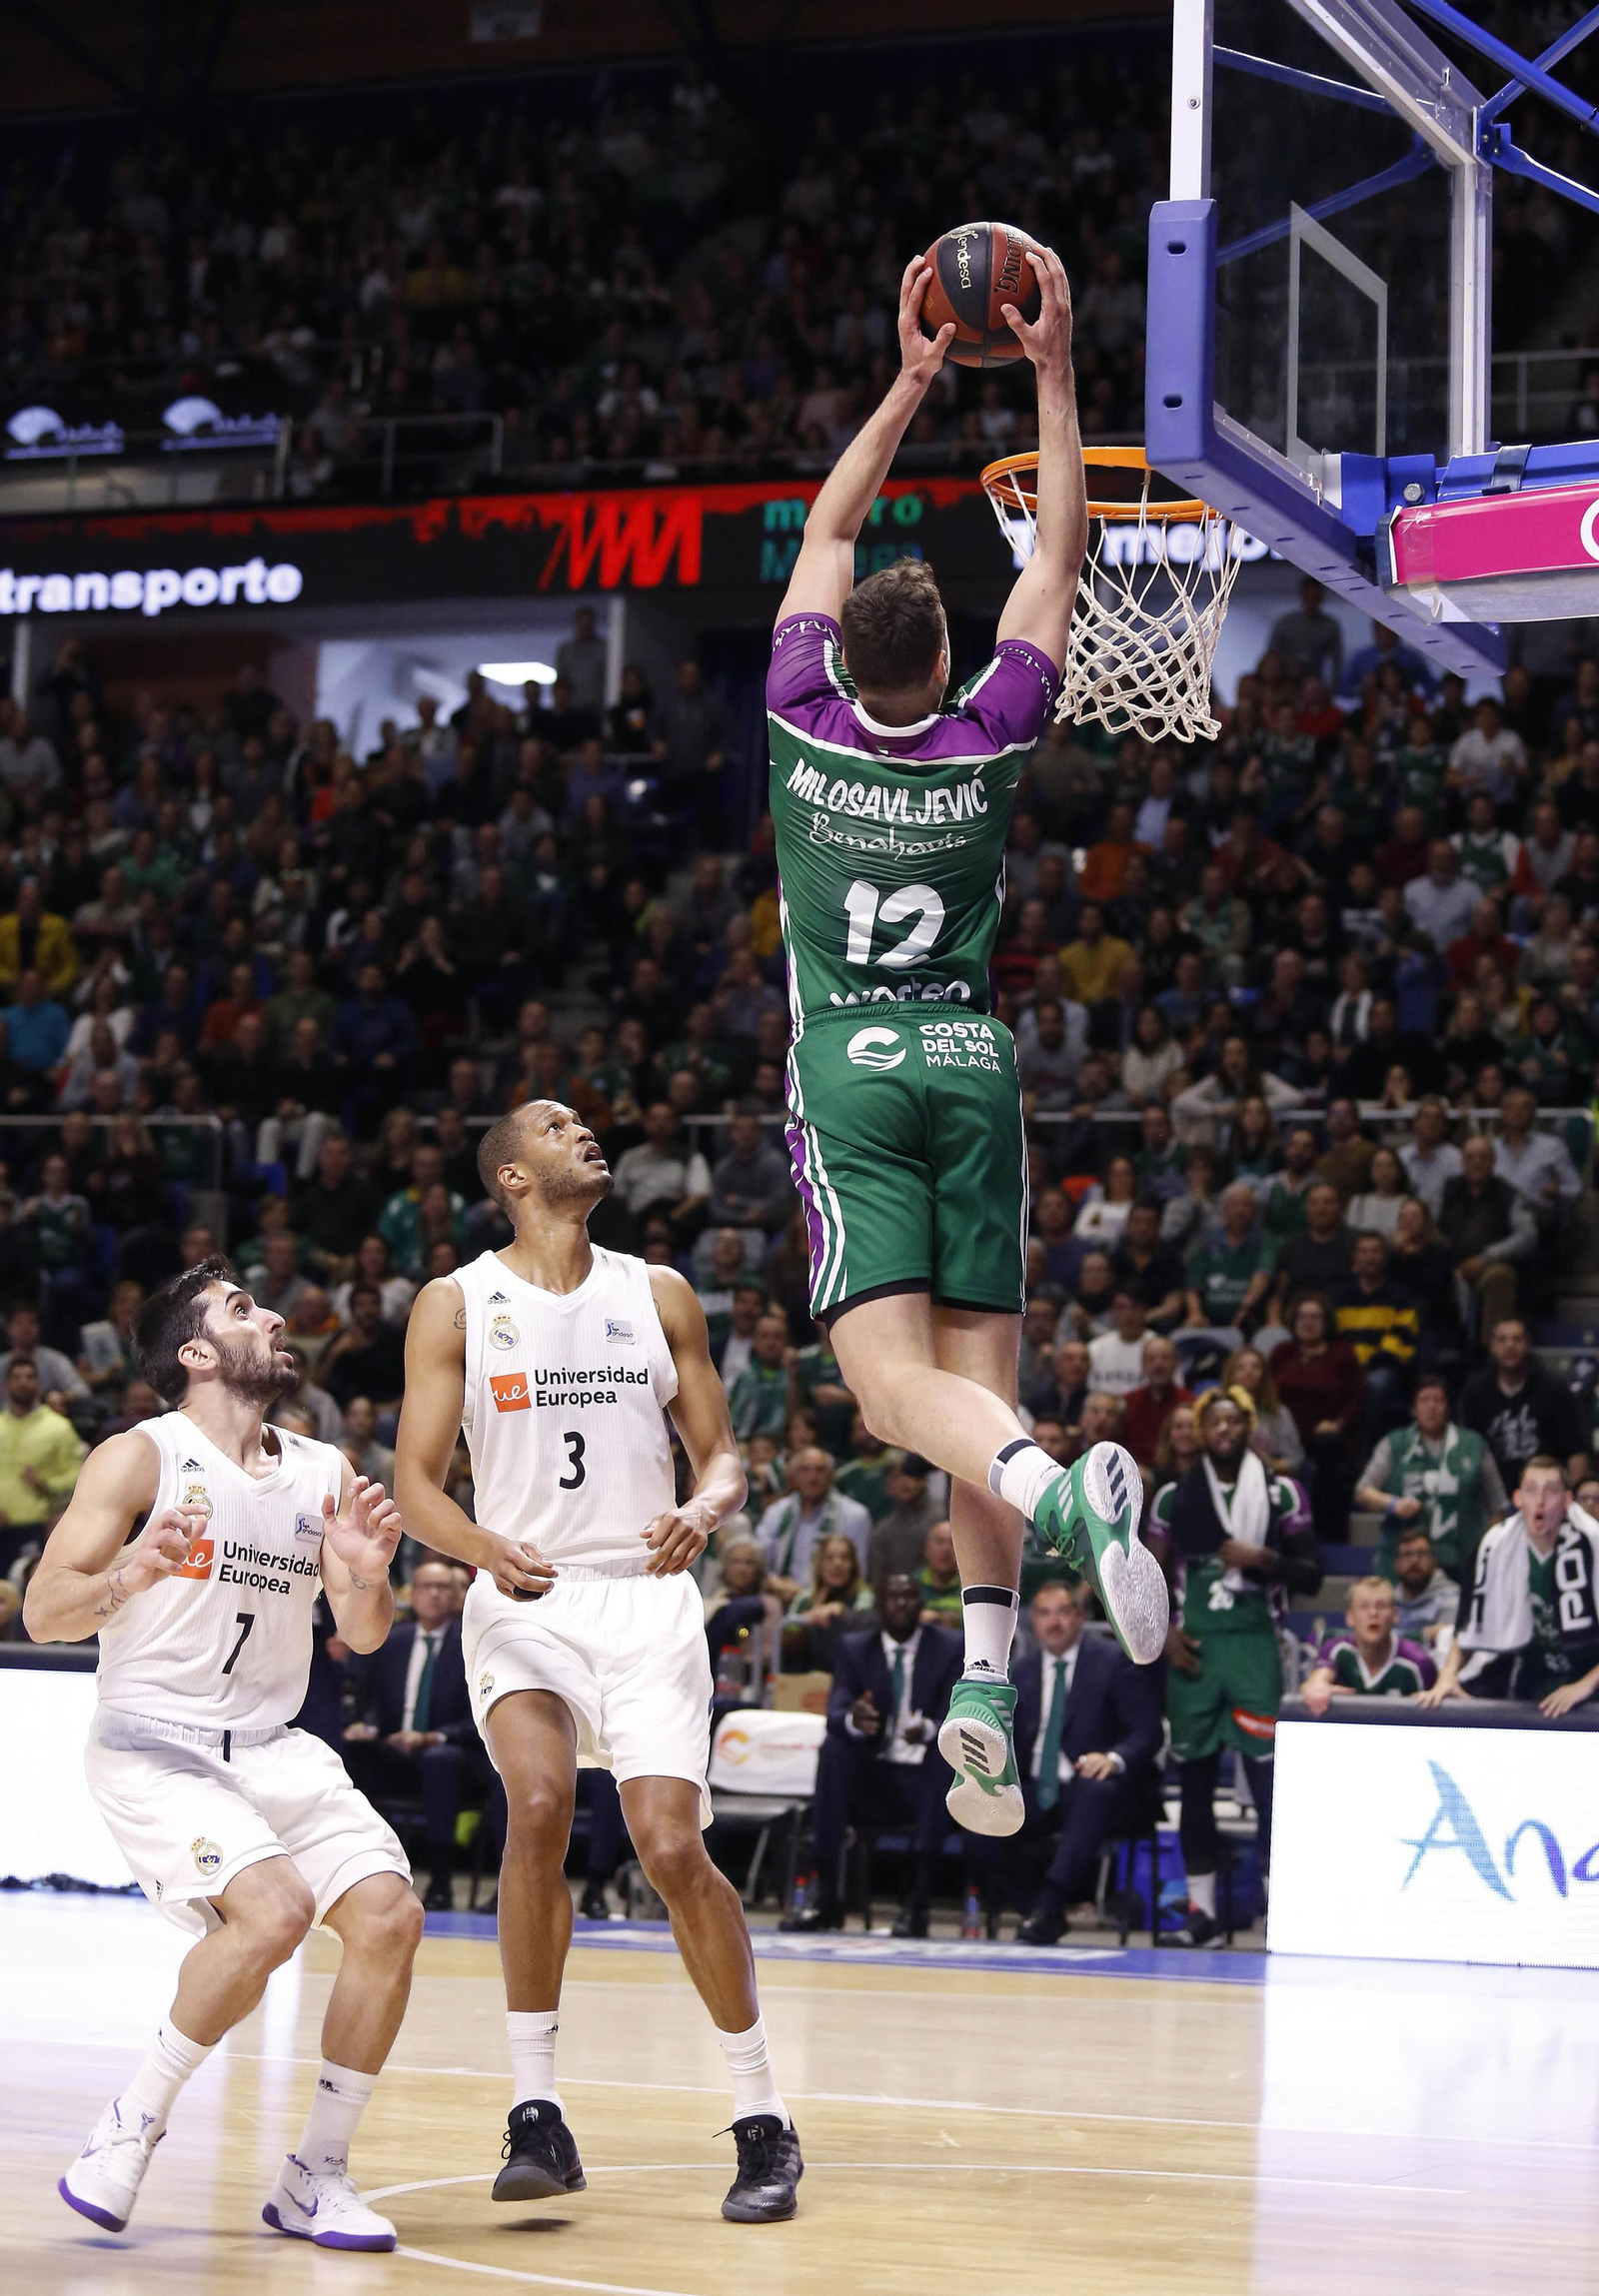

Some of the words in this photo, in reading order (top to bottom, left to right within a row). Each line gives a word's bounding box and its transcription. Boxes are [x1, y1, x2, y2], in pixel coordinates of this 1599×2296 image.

[763, 493, 924, 532] mro
[0, 557, 303, 616] transporte
[786, 757, 988, 825] MILOSAVLJEVIĆ
[843, 879, 946, 969] 12
[918, 1021, 995, 1041] COSTA
[921, 1038, 962, 1054] DEL
[964, 1039, 999, 1059] SOL
[925, 1052, 1002, 1074] MÁLAGA
[534, 1365, 649, 1387] Universidad
[535, 1388, 618, 1409] Europea
[559, 1431, 587, 1490] 3
[218, 1564, 291, 1595] Europea
[221, 1612, 255, 1676] 7
